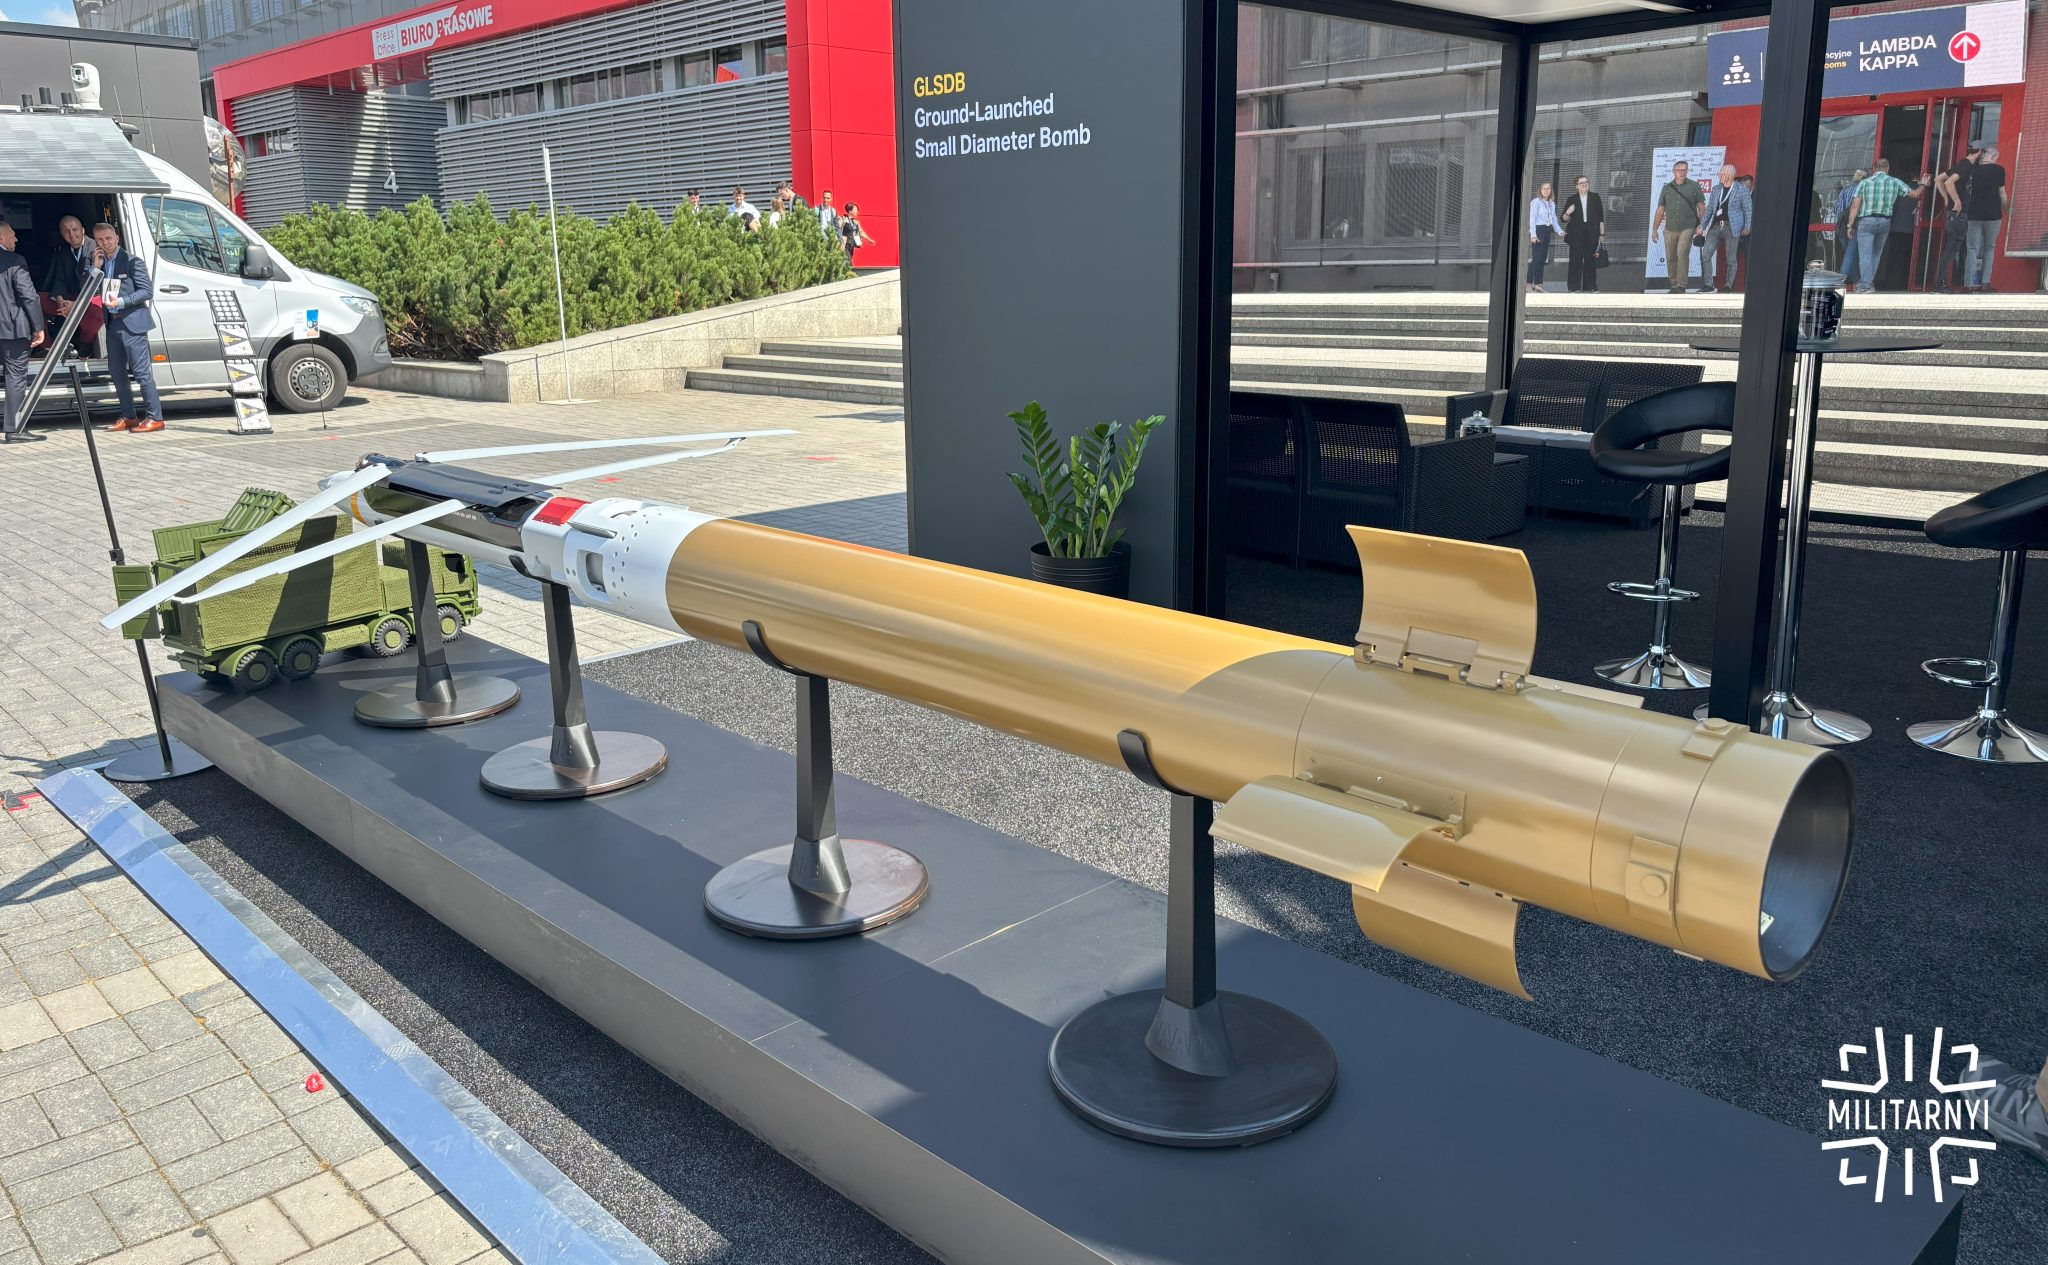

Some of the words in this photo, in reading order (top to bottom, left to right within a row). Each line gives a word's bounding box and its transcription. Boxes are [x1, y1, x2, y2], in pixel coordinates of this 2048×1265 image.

[376, 30, 394, 43] Press
[400, 22, 434, 47] BIURO
[436, 5, 494, 38] PRASOWE
[377, 43, 395, 56] Office
[1825, 50, 1852, 60] ncyjne
[1859, 34, 1937, 55] LAMBDA
[1824, 61, 1847, 69] ooms
[1859, 53, 1919, 72] KAPPA
[913, 71, 967, 98] GLSDB
[914, 92, 1055, 128] Ground-Launched
[915, 135, 957, 159] Small
[960, 130, 1036, 155] Diameter
[1039, 123, 1091, 148] Bomb
[383, 171, 399, 193] 4
